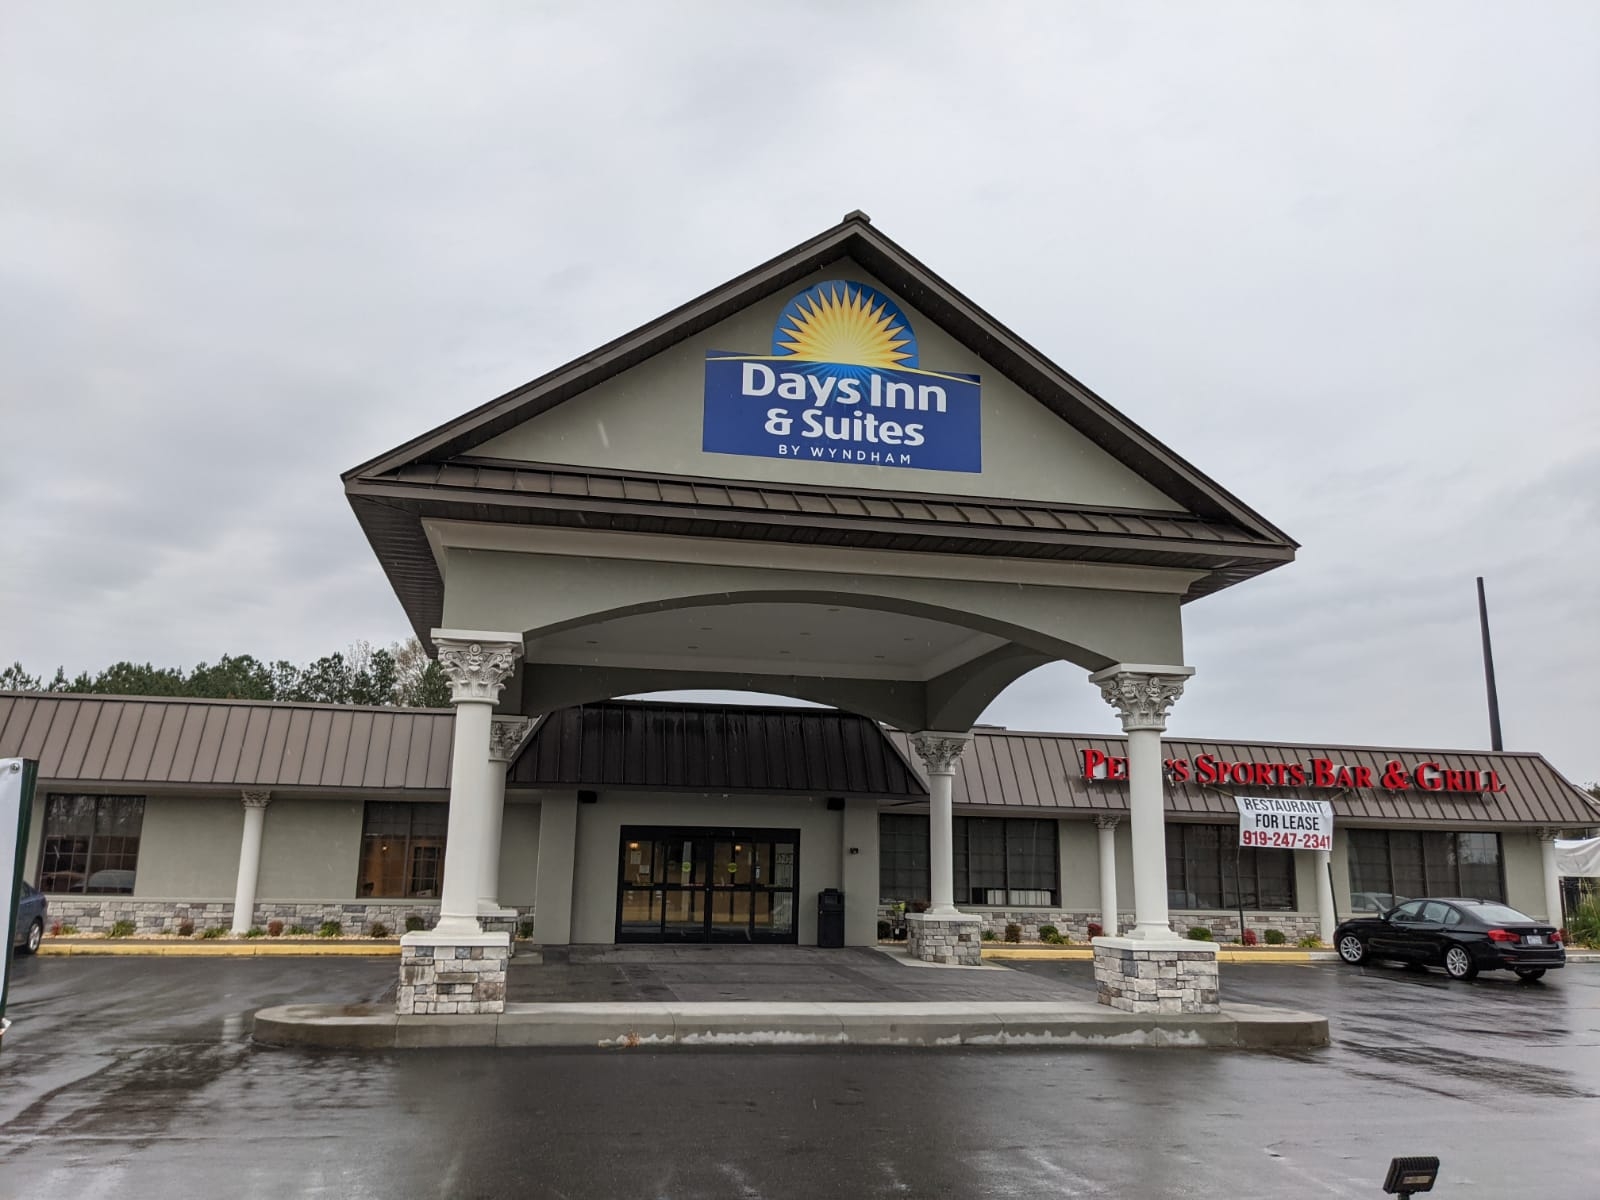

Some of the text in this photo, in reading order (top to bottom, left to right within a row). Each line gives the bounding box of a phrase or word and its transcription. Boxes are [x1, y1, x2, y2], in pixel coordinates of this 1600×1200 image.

[742, 362, 947, 412] Days Inn
[764, 408, 925, 446] & Suites
[778, 444, 912, 464] BY WYNDHAM
[1195, 754, 1306, 786] SPORTS
[1309, 758, 1372, 788] BAR
[1381, 760, 1409, 790] &
[1415, 762, 1507, 793] GRILL
[1243, 798, 1323, 815] RESTAURANT
[1255, 813, 1320, 831] FOR LEASE
[1243, 830, 1331, 849] 919-247-2341
